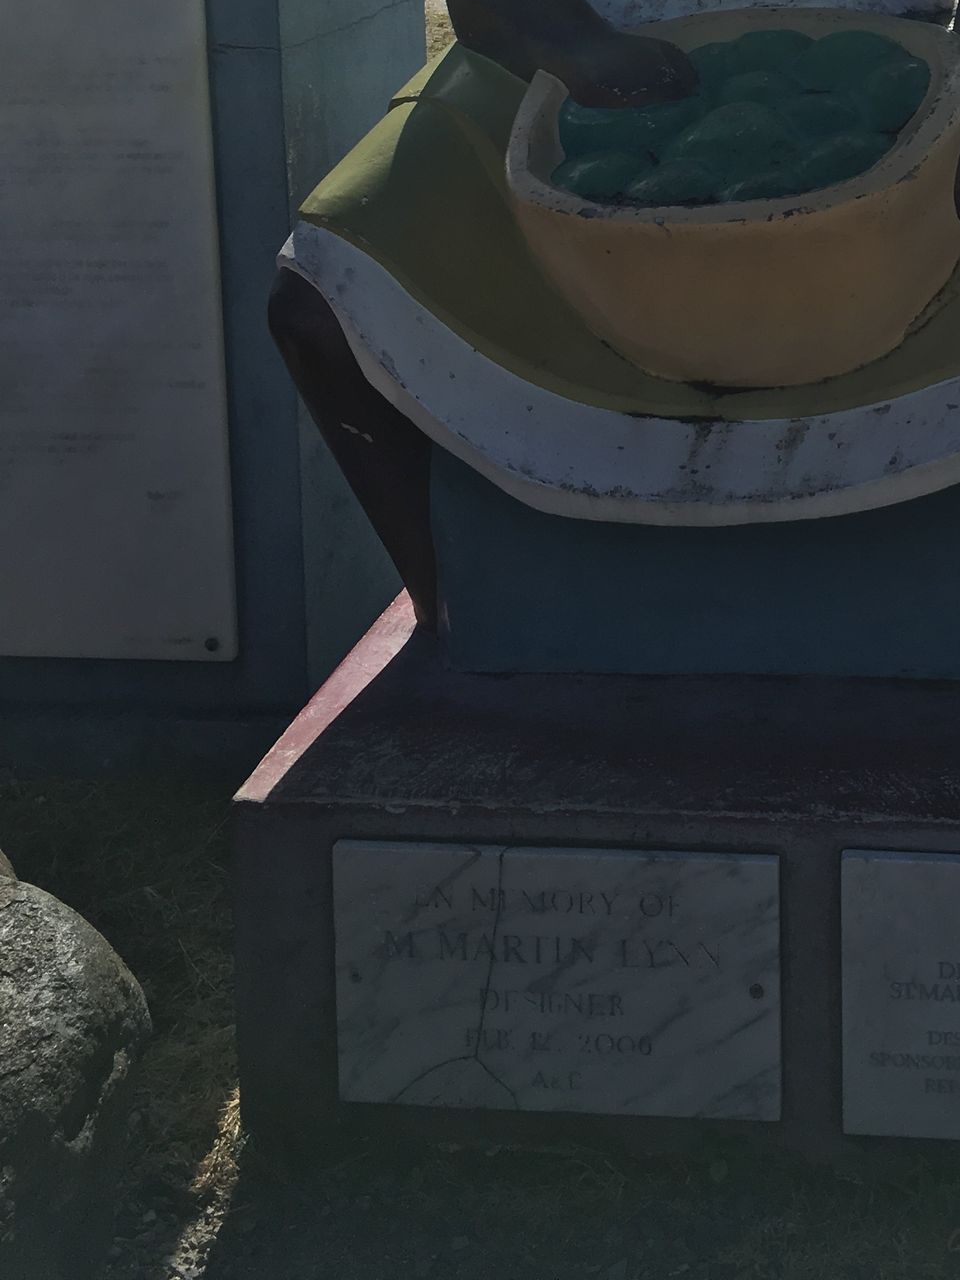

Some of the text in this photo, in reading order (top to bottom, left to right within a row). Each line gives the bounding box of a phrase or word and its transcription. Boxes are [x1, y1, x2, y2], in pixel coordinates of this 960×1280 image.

[639, 892, 681, 917] OF
[439, 930, 595, 964] MARTIN
[620, 938, 721, 969] LYNN
